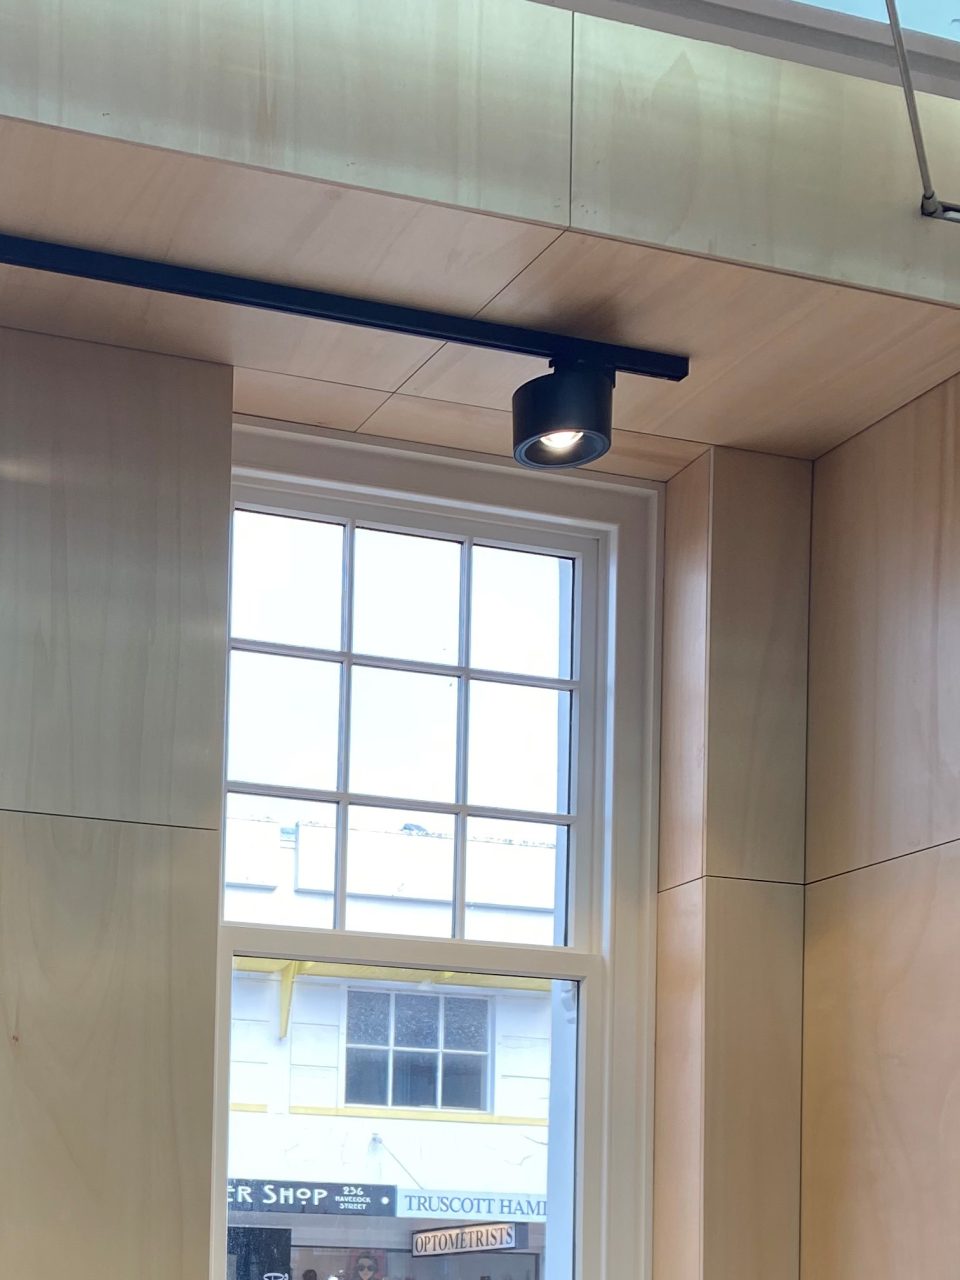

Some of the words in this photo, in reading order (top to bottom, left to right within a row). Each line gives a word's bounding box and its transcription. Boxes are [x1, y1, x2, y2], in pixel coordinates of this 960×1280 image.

[338, 1202, 367, 1210] STREET
[405, 1195, 496, 1213] TRUSCOTT
[415, 1226, 513, 1254] OPTOMETRISTS
